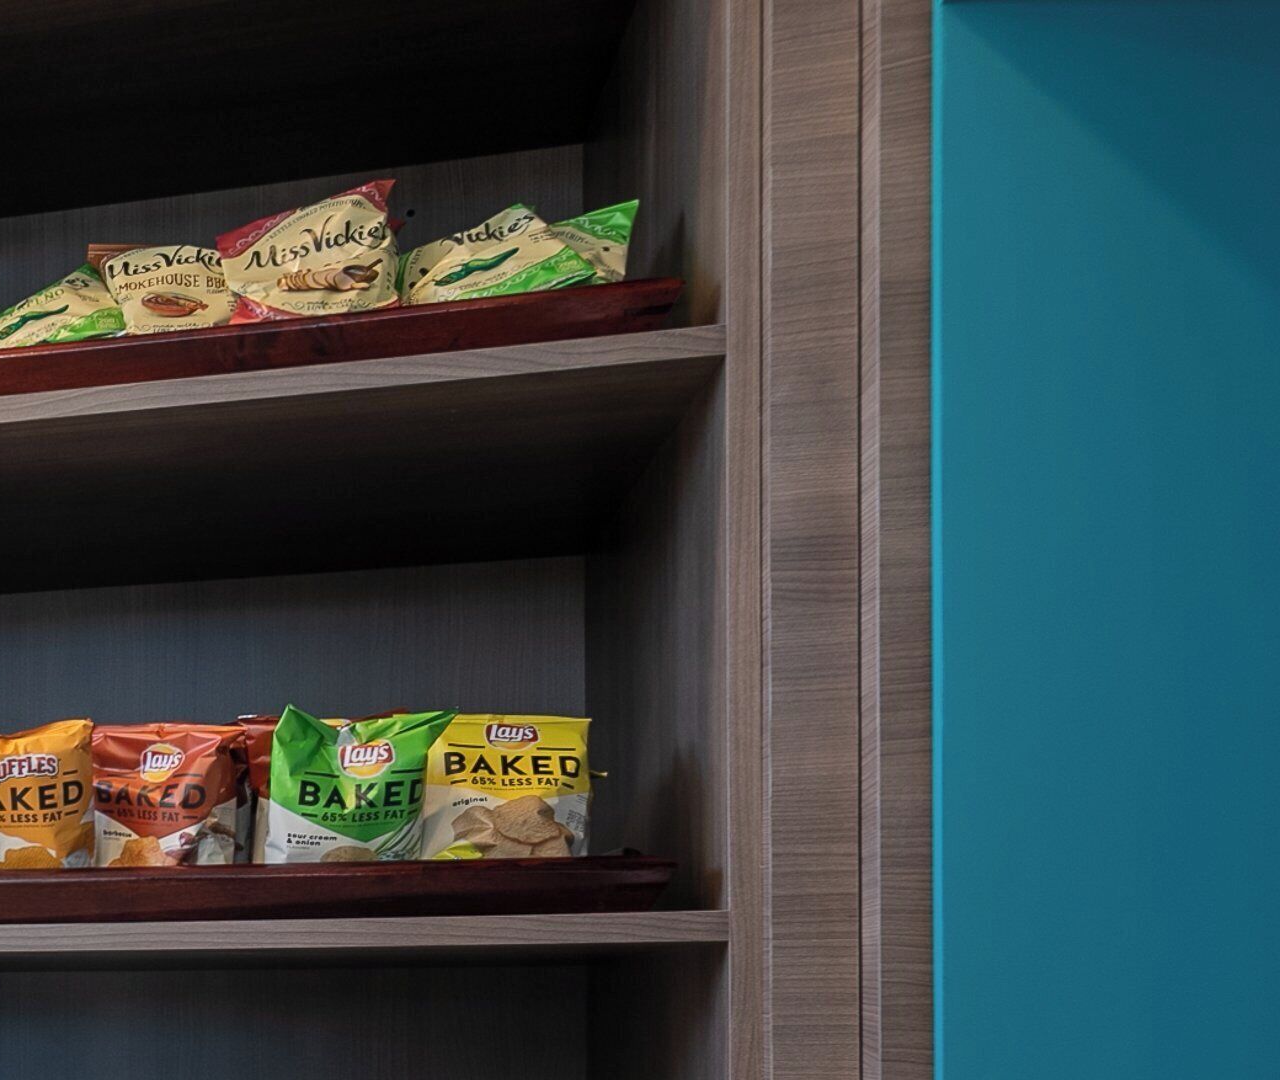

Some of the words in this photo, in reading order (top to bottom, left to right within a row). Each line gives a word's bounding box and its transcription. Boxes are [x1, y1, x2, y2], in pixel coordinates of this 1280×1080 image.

[244, 242, 310, 271] Miss
[444, 752, 580, 777] BAKED
[471, 775, 496, 786] 65%
[501, 776, 532, 787] LESS
[537, 776, 560, 787] FAT
[95, 780, 207, 810] BAKED
[298, 779, 423, 812] BAKED
[452, 796, 488, 808] original
[10, 812, 39, 824] LESS
[42, 810, 63, 822] FAT
[116, 808, 134, 819] 65%
[137, 809, 162, 821] LESS
[163, 811, 180, 822] FAT
[321, 810, 347, 823] 65%
[351, 810, 381, 823] LESS
[383, 808, 405, 821] FAT
[102, 829, 132, 838] barbecue
[309, 833, 338, 842] cream
[294, 839, 321, 847] onion
